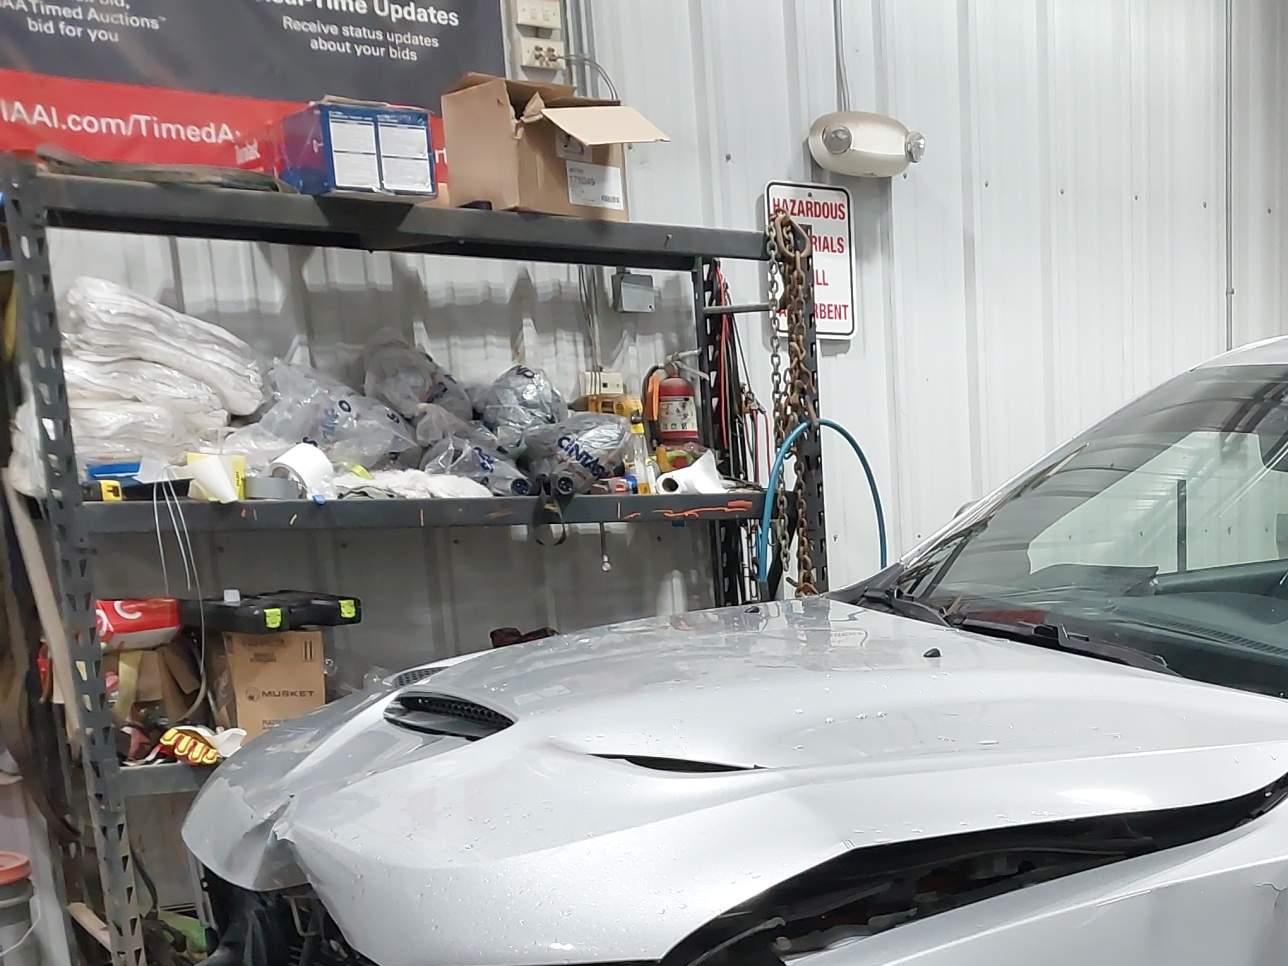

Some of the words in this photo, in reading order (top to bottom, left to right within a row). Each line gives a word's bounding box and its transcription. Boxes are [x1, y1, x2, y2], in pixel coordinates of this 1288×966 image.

[28, 0, 83, 20] Timed
[373, 0, 460, 26] Updates
[26, 17, 55, 34] bid
[58, 22, 83, 38] for
[87, 27, 119, 42] you
[282, 16, 339, 36] Receive
[342, 24, 383, 41] status
[387, 32, 439, 48] updates
[310, 37, 352, 54] about
[354, 43, 386, 57] your
[389, 46, 418, 61] bids
[0, 98, 240, 143] IAAI.com/TimedA
[772, 198, 846, 220] HAZARDOUS
[261, 690, 315, 698] MUSKET
